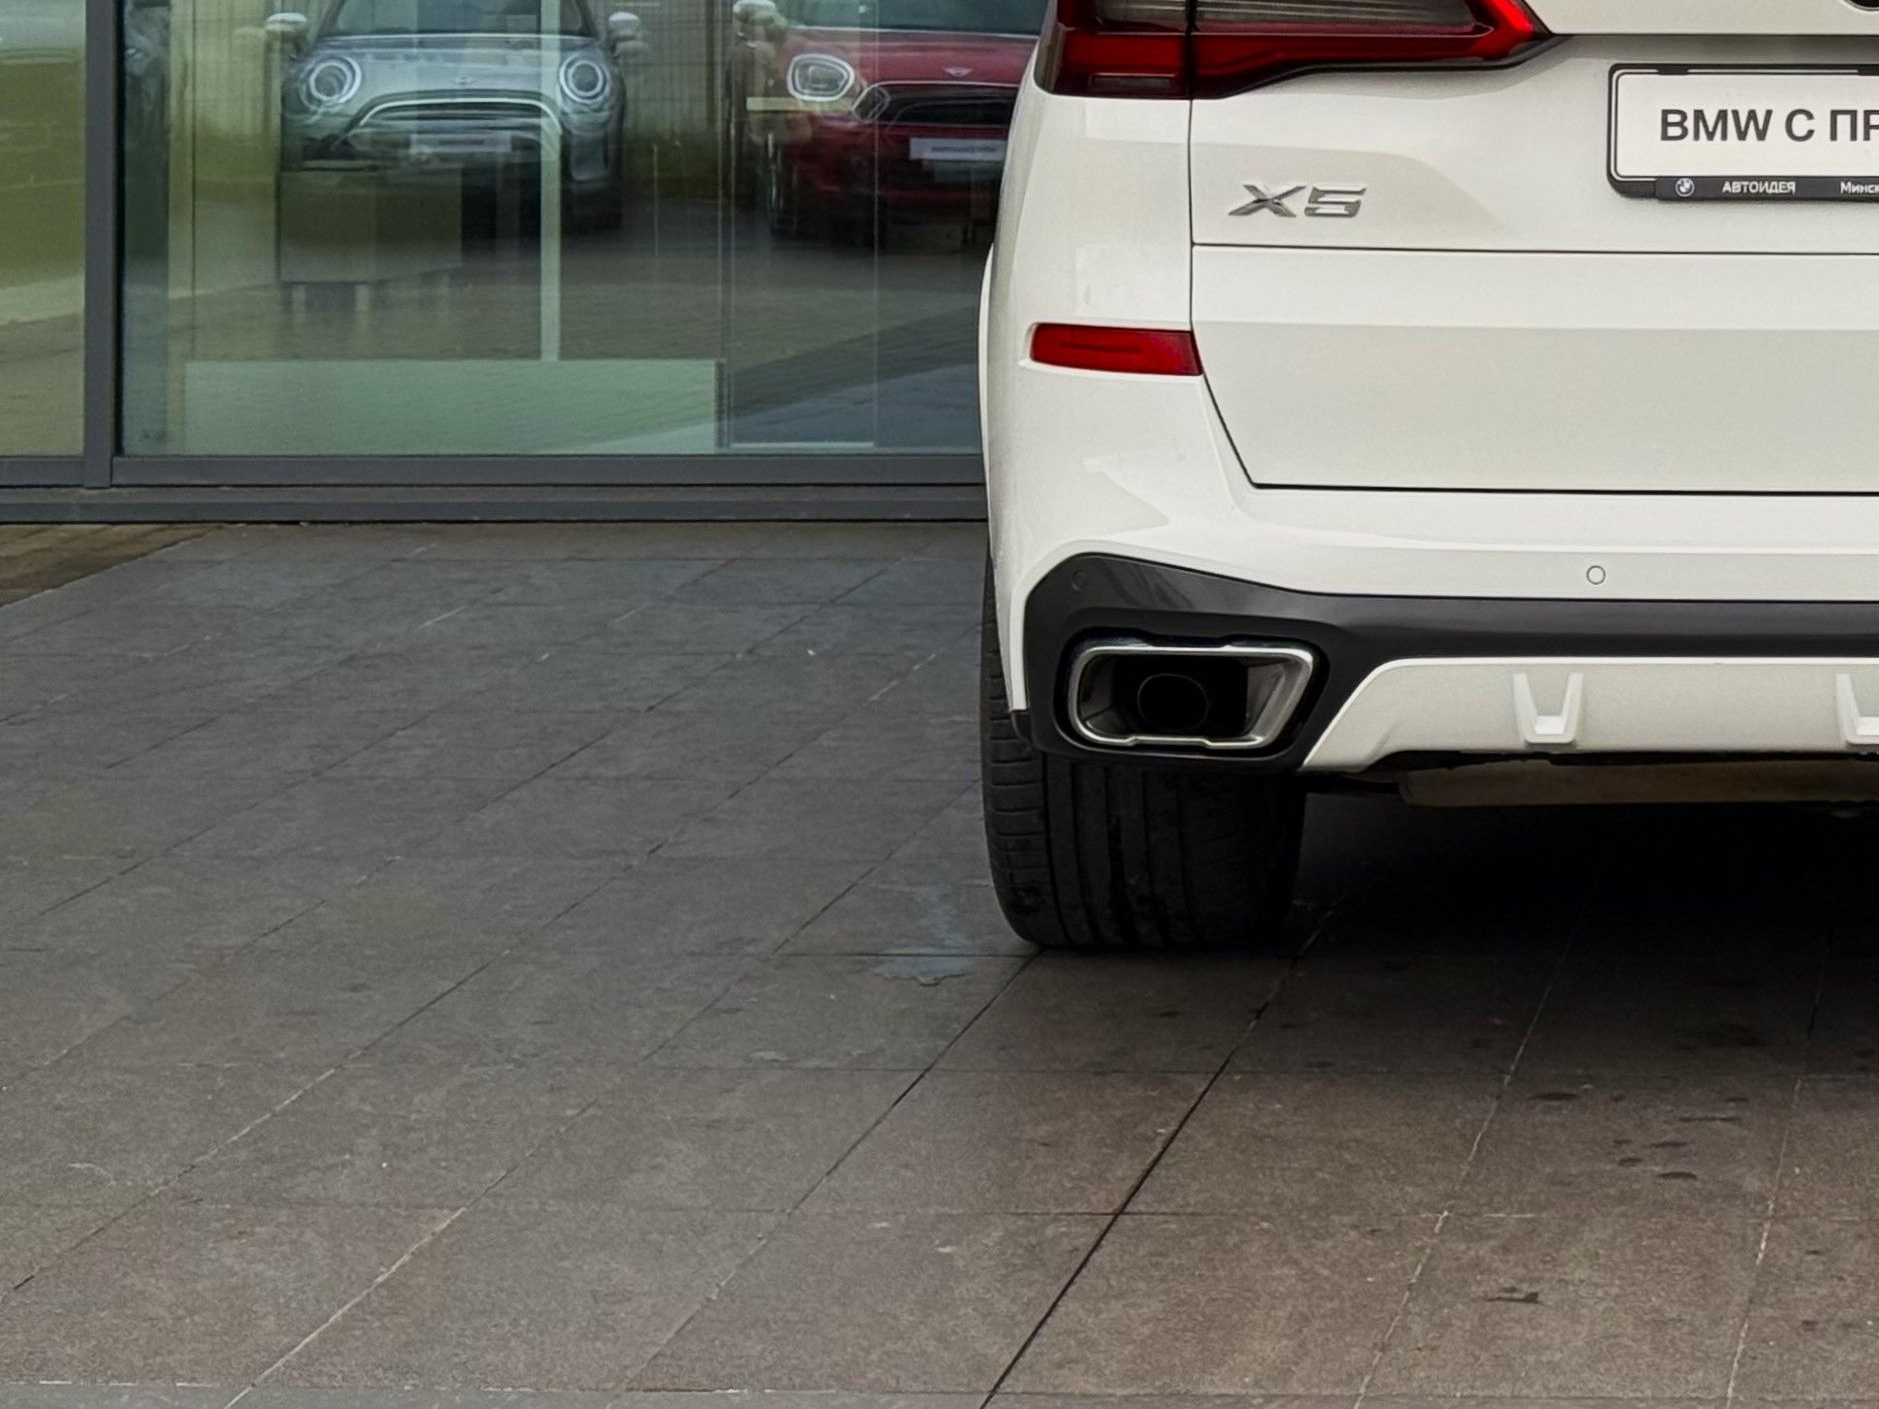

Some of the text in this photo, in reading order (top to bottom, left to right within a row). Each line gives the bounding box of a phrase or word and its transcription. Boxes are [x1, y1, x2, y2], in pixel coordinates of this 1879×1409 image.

[1660, 108, 1773, 142] BMW
[1784, 108, 1815, 142] С
[1227, 184, 1367, 218] X5
[1721, 180, 1796, 195] АВТОИДЕЯ
